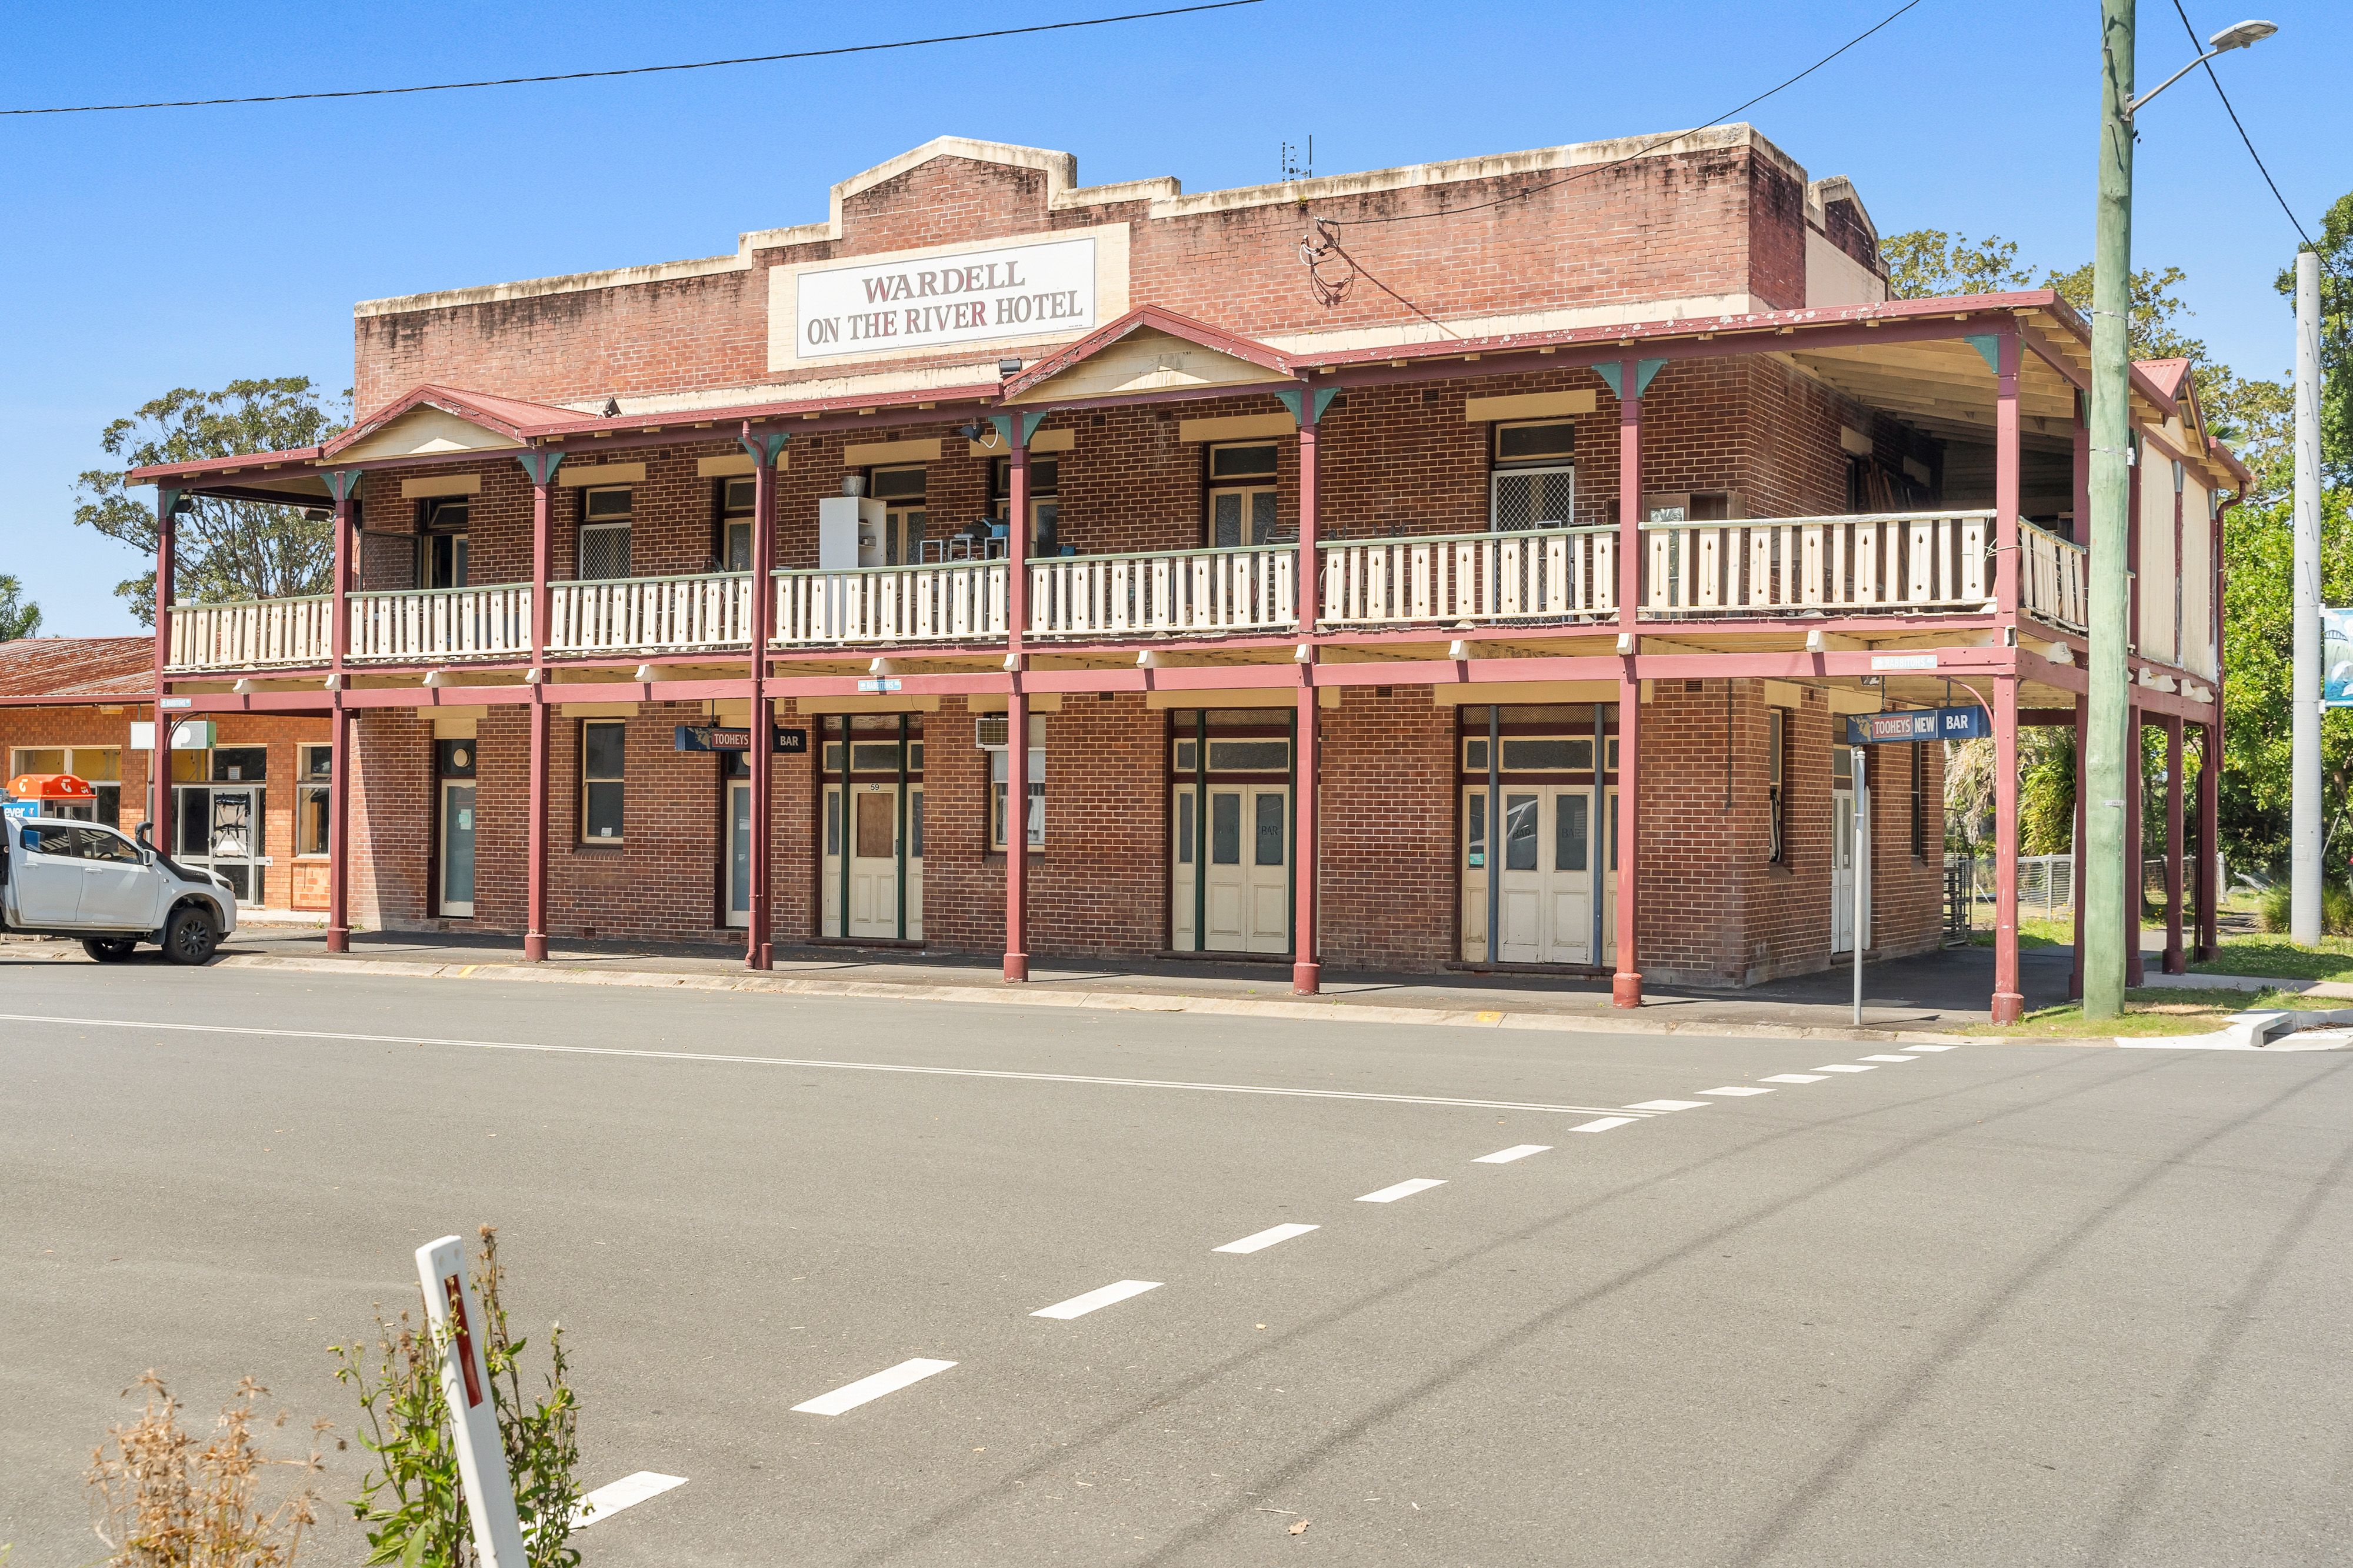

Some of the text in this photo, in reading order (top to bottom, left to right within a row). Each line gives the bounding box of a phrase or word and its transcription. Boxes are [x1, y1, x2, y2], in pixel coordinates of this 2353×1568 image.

[862, 261, 1025, 304] WARDELL
[808, 290, 1083, 345] ON THE RIVER HOTEL
[1874, 715, 1968, 735] TOOHEYS NEW BAR
[714, 733, 799, 746] TOOHEYS BAR
[1261, 826, 1278, 835] BAR
[1513, 829, 1531, 838] BAR
